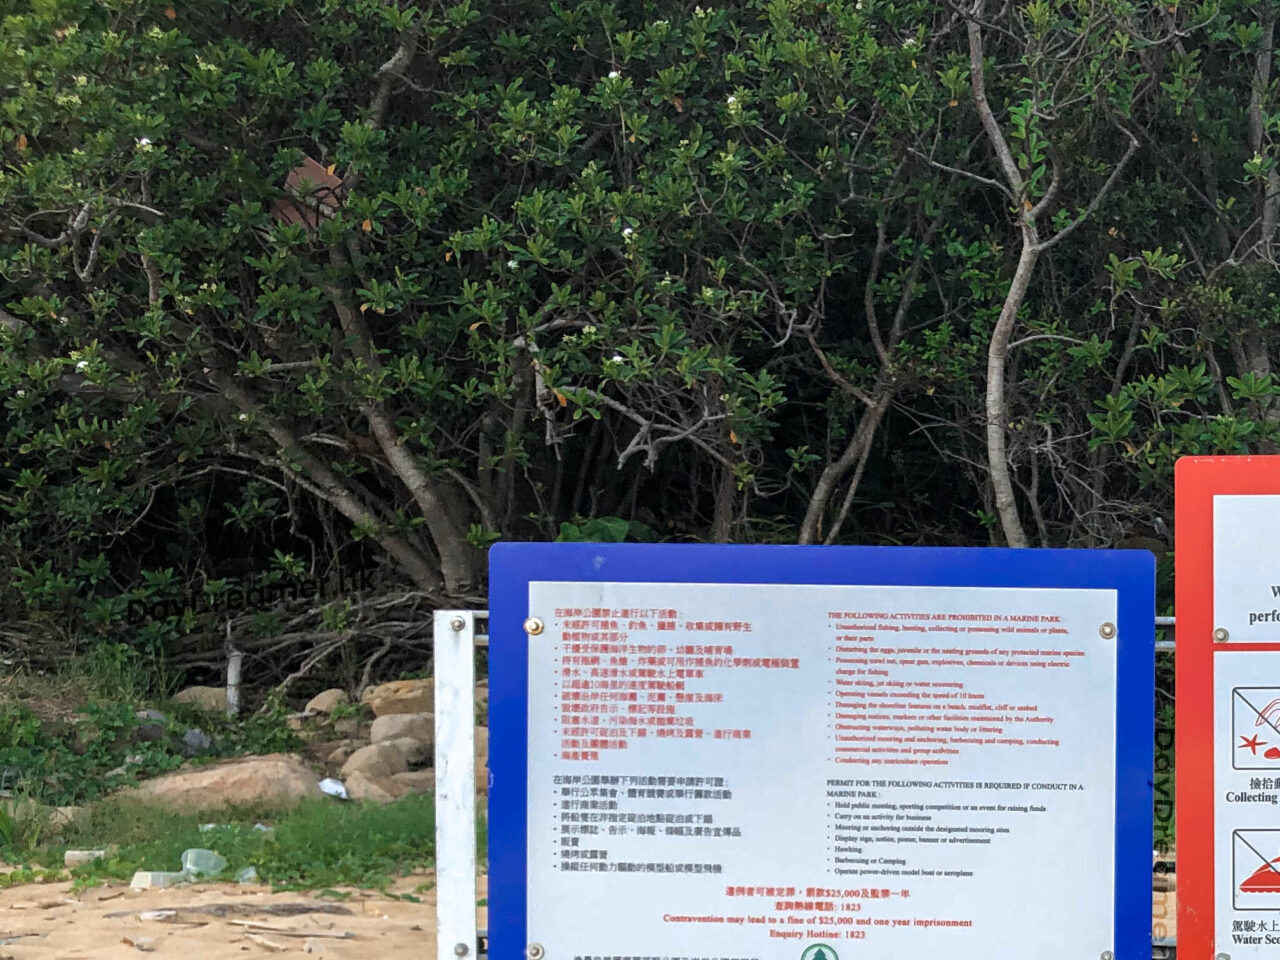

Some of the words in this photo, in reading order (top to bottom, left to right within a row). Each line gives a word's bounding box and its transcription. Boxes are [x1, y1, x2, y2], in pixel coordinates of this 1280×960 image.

[1225, 791, 1278, 805] Collecting
[662, 913, 724, 923] Contravention
[726, 916, 744, 925] may
[747, 915, 766, 924] lead
[767, 916, 777, 924] to
[787, 915, 804, 924] fine
[806, 916, 817, 924] of
[818, 915, 853, 926] $25,000
[855, 916, 871, 925] and
[891, 919, 910, 928] year
[913, 918, 972, 929] imprisonment
[769, 929, 804, 940] Enquiry
[806, 929, 841, 938] Hotline:
[845, 930, 865, 939] 1823
[1231, 933, 1263, 945] Water
